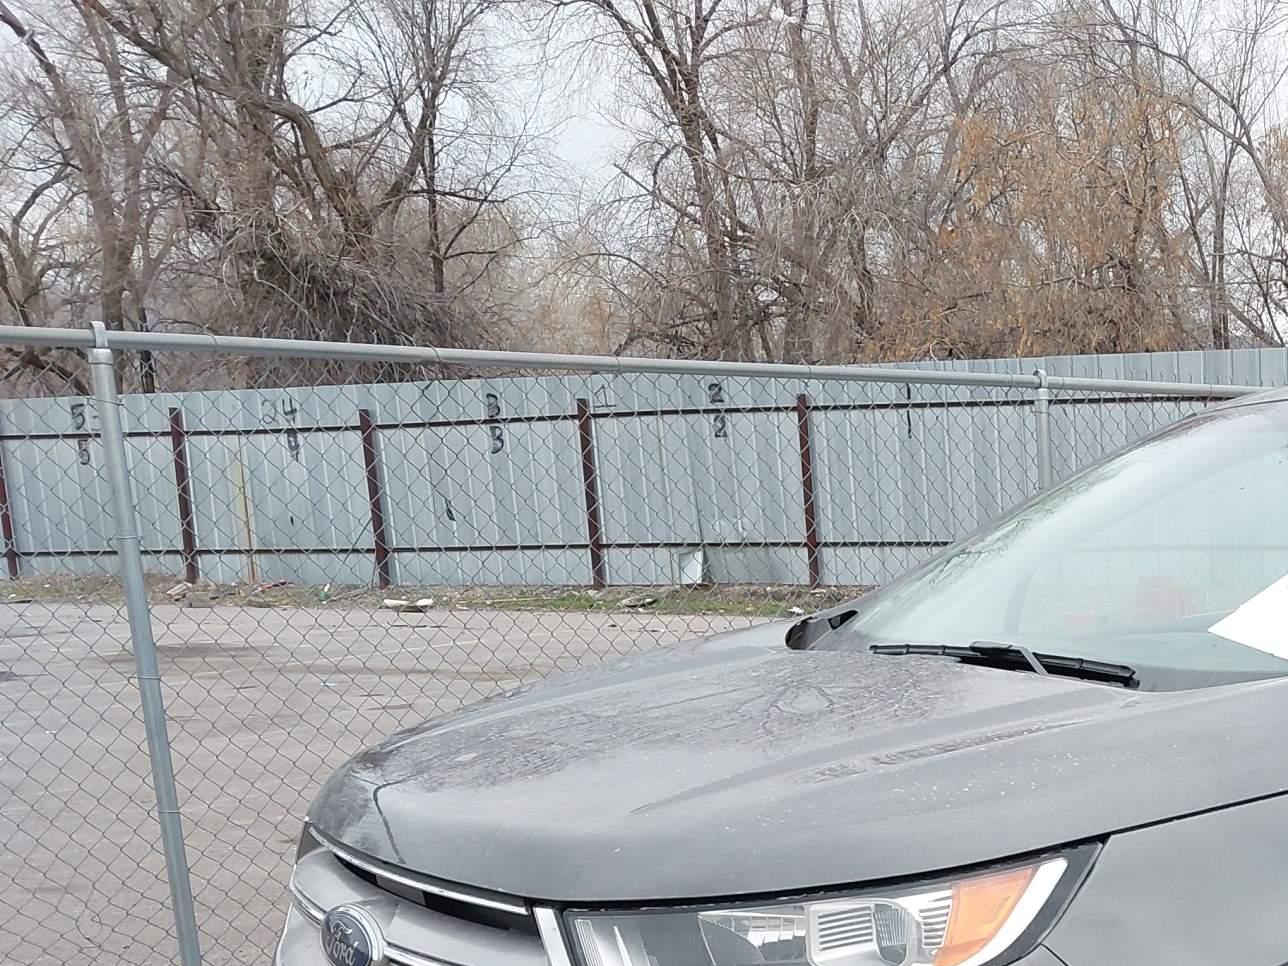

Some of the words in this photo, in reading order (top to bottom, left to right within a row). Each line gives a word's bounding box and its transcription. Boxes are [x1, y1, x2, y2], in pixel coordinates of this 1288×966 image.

[593, 383, 617, 409] 1
[707, 383, 725, 405] 2
[70, 403, 86, 431] 5
[713, 415, 728, 438] 2
[77, 439, 91, 465] 5
[325, 919, 359, 966] Ford
